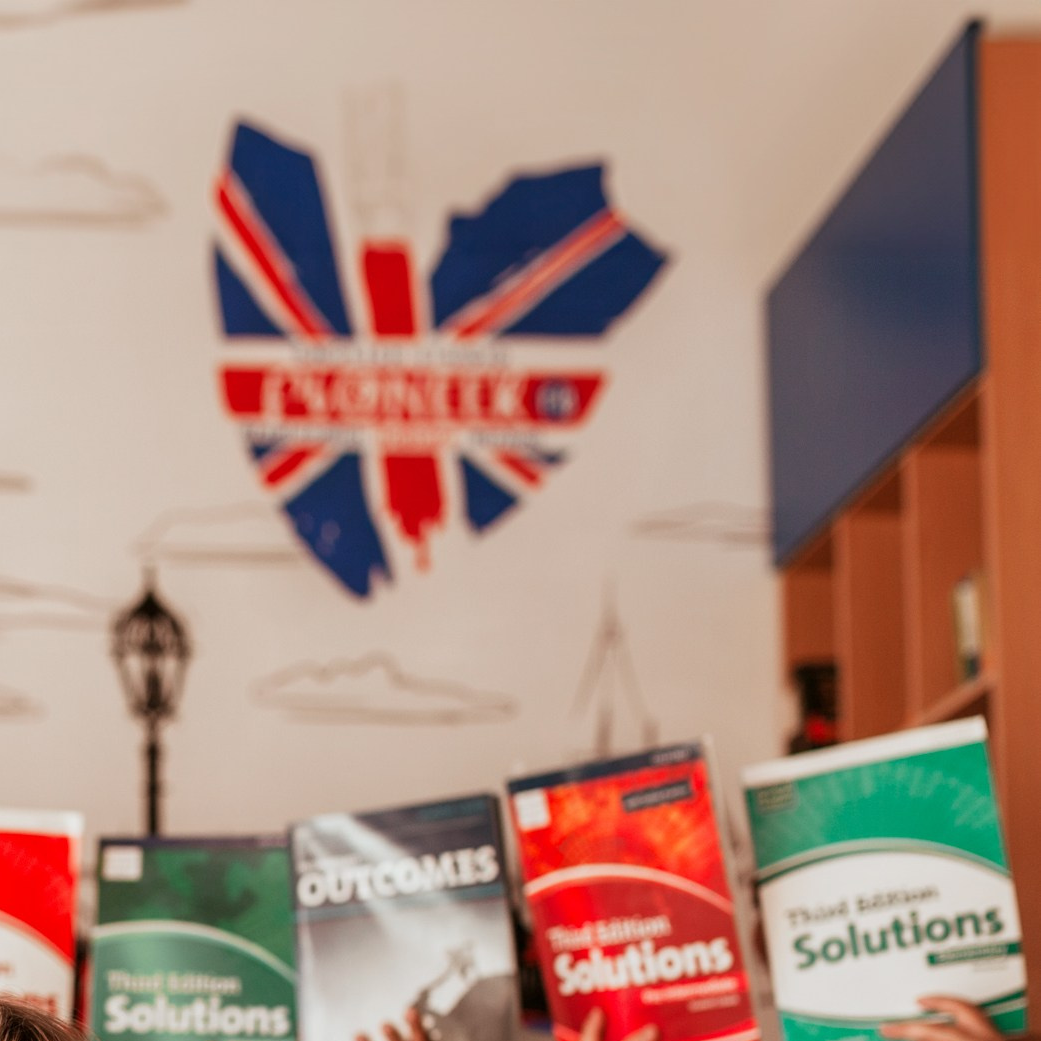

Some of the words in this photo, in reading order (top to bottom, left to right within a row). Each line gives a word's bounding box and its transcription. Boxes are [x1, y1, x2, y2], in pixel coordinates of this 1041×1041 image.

[296, 845, 499, 907] OUTCOMES
[787, 901, 848, 926] Third
[856, 885, 939, 913] Edition
[546, 921, 593, 952] Third
[595, 915, 671, 949] Edition
[794, 906, 1004, 970] Solutions
[107, 970, 162, 992] Third
[167, 972, 241, 994] Edition
[553, 937, 733, 996] Solutions
[105, 994, 290, 1036] Solutions
